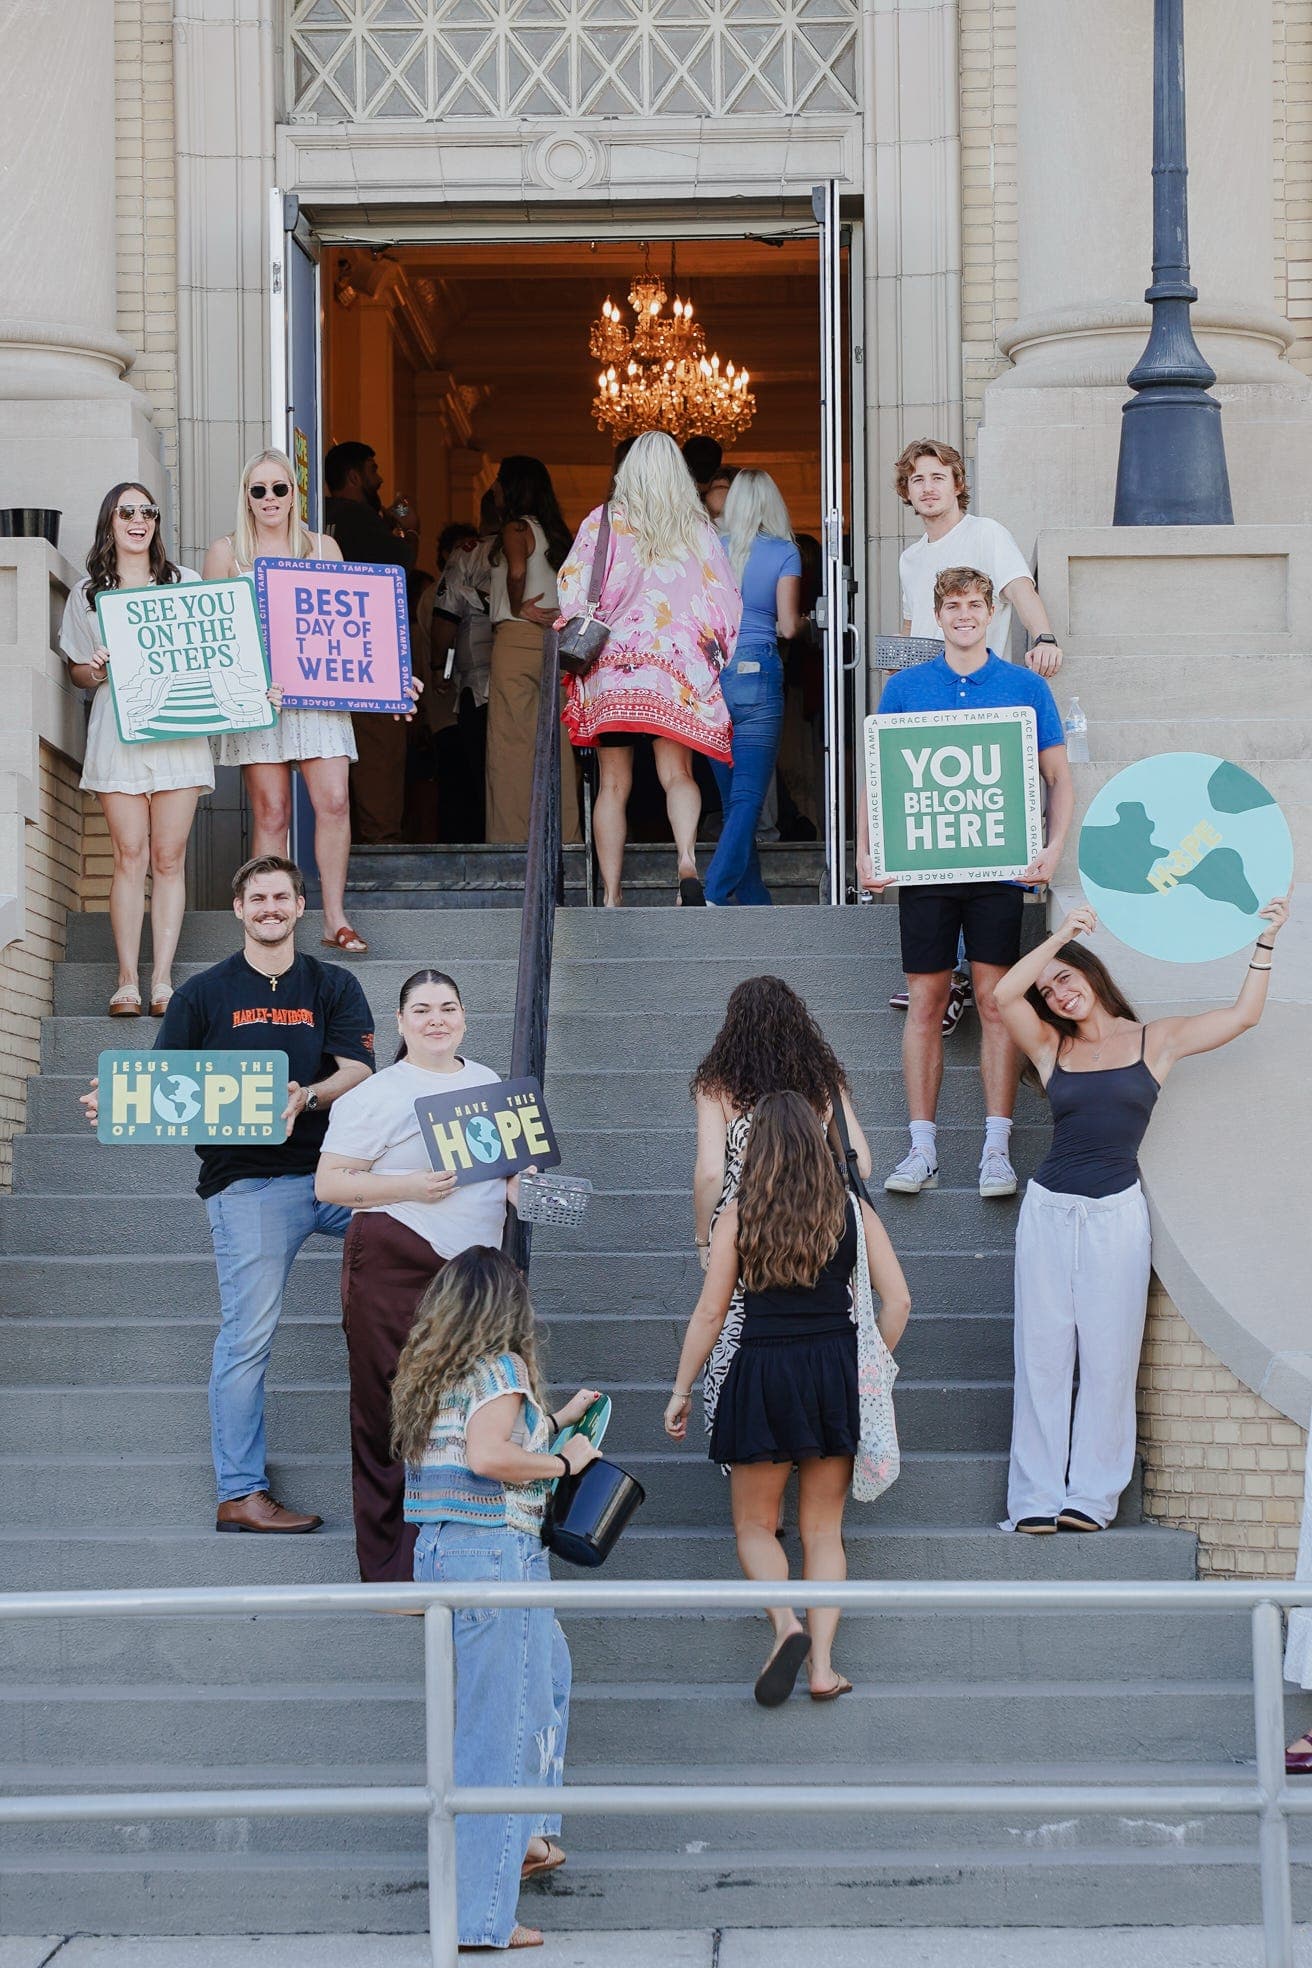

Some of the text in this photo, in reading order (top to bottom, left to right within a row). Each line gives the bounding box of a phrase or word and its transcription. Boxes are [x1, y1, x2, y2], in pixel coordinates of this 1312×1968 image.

[278, 560, 311, 569] GRACE
[315, 562, 338, 571] CITY
[342, 564, 374, 573] TAMPA
[126, 590, 235, 625] SEE YOU
[259, 597, 267, 618] CITY
[294, 587, 370, 618] BEST
[397, 598, 406, 620] CITY
[137, 617, 236, 650] ON THE
[295, 617, 371, 639] DAY OF
[399, 625, 408, 656] TAMPA
[147, 643, 234, 675] STEPS
[296, 656, 375, 684] WEEK
[302, 698, 336, 707] GRACE
[347, 700, 381, 709] TAMPA
[384, 702, 407, 710] CITY
[890, 716, 928, 725] GRACE
[933, 714, 958, 723] CITY
[963, 712, 1000, 721] TAMPA
[900, 743, 1002, 788] YOU
[1026, 746, 1034, 770] CITY
[870, 761, 878, 787] CITY
[903, 787, 1005, 814] BELONG
[1028, 777, 1036, 812] TAMPA
[870, 791, 880, 829] GRACE
[905, 811, 1006, 851] HERE
[874, 841, 882, 877] TAMPA
[895, 874, 912, 882] CIT
[917, 872, 954, 881] GRACE
[968, 870, 1005, 879] TAMPA
[232, 1007, 315, 1029] HARLEY-DAVIDSON
[112, 1061, 274, 1073] JESUS IS THE
[111, 1074, 274, 1124] HOPE
[428, 1093, 536, 1122] I HAVE THIS
[112, 1125, 273, 1136] OF THE WORLD
[431, 1105, 551, 1171] HOPE
